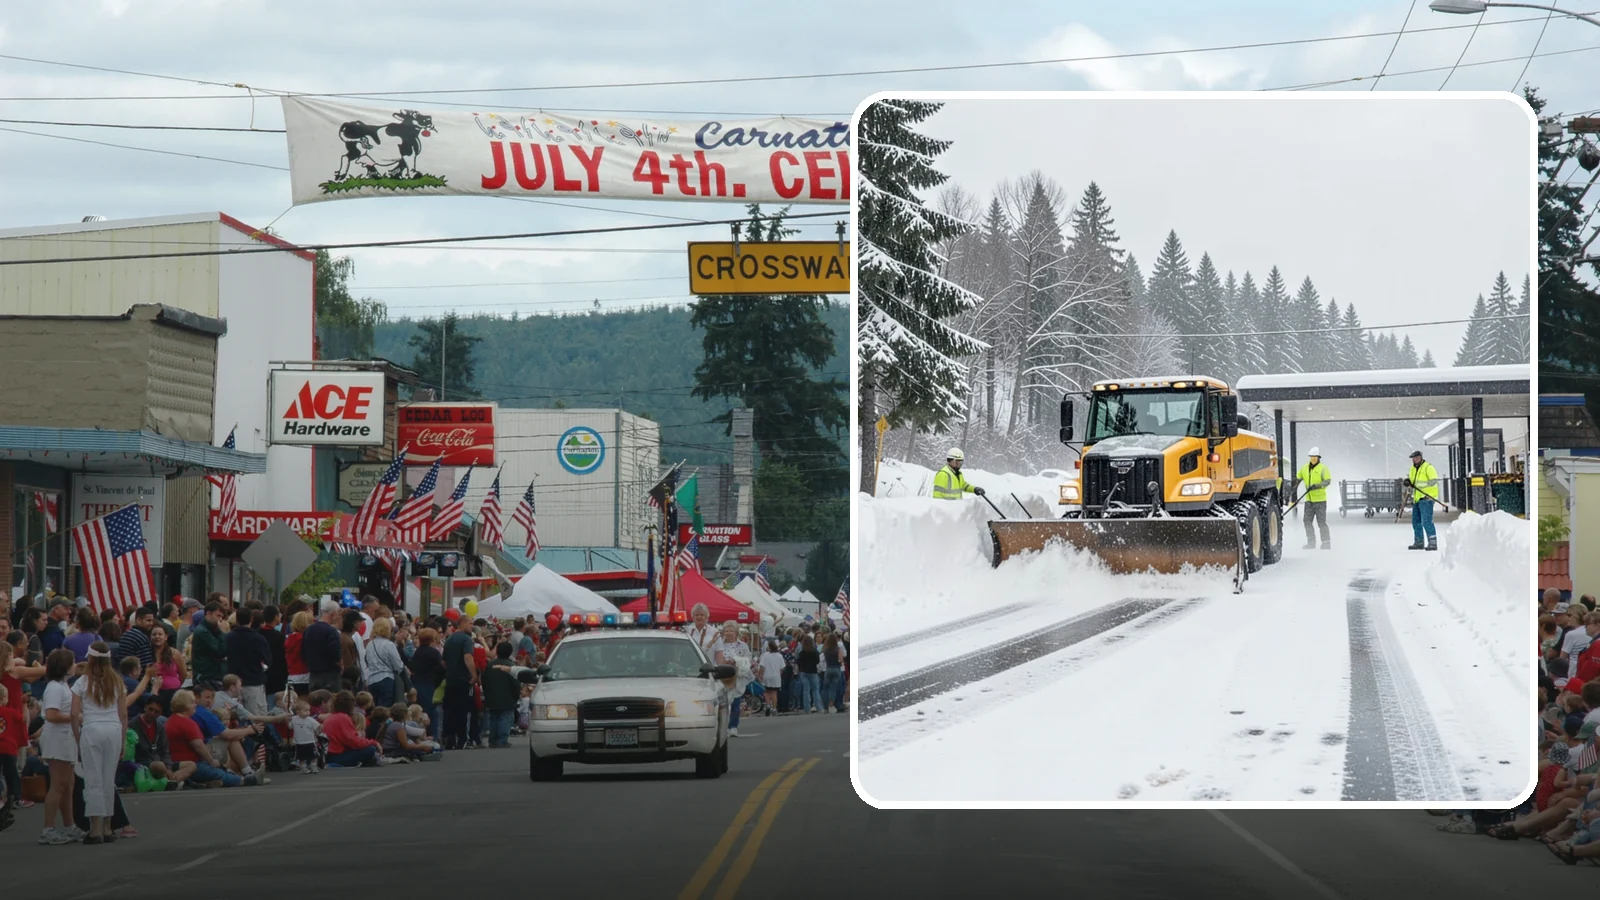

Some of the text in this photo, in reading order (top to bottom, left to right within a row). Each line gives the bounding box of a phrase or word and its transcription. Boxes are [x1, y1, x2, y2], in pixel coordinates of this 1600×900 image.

[481, 140, 604, 193] JULY
[632, 149, 746, 198] 4th.
[696, 254, 850, 280] CROSSWA
[283, 380, 374, 420] ACE
[405, 409, 452, 422] CEDAR
[283, 421, 371, 436] Hardware
[416, 428, 477, 447] Coca-Cola
[353, 467, 386, 479] Simpl
[83, 485, 155, 495] St. Vincent de Paul
[688, 526, 741, 535] CRNATION
[699, 535, 730, 543] GLASS
